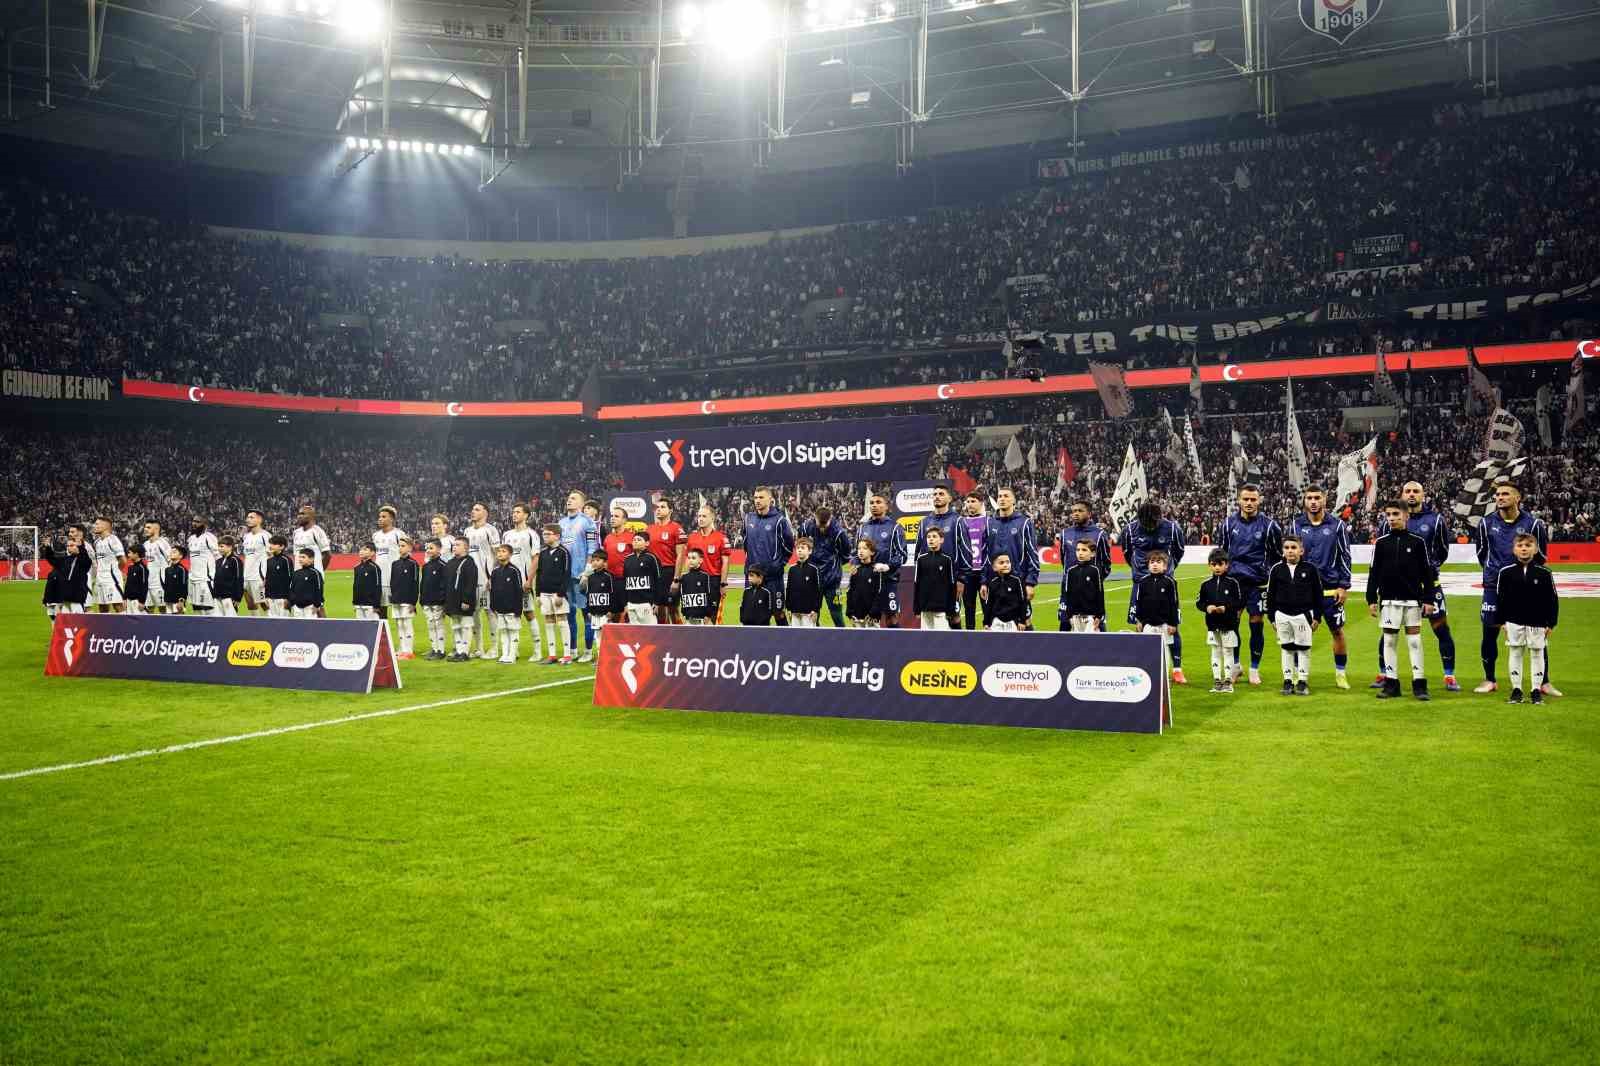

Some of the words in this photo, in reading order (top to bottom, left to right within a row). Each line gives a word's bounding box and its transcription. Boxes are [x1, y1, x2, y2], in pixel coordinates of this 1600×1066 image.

[1320, 13, 1363, 30] 1903
[689, 439, 791, 470] trendyol
[889, 599, 897, 611] 6
[88, 633, 160, 659] trendyol
[662, 652, 780, 686] trendyol
[995, 668, 1049, 683] trendyol
[1003, 682, 1040, 694] yemek
[1075, 678, 1092, 687] Türk
